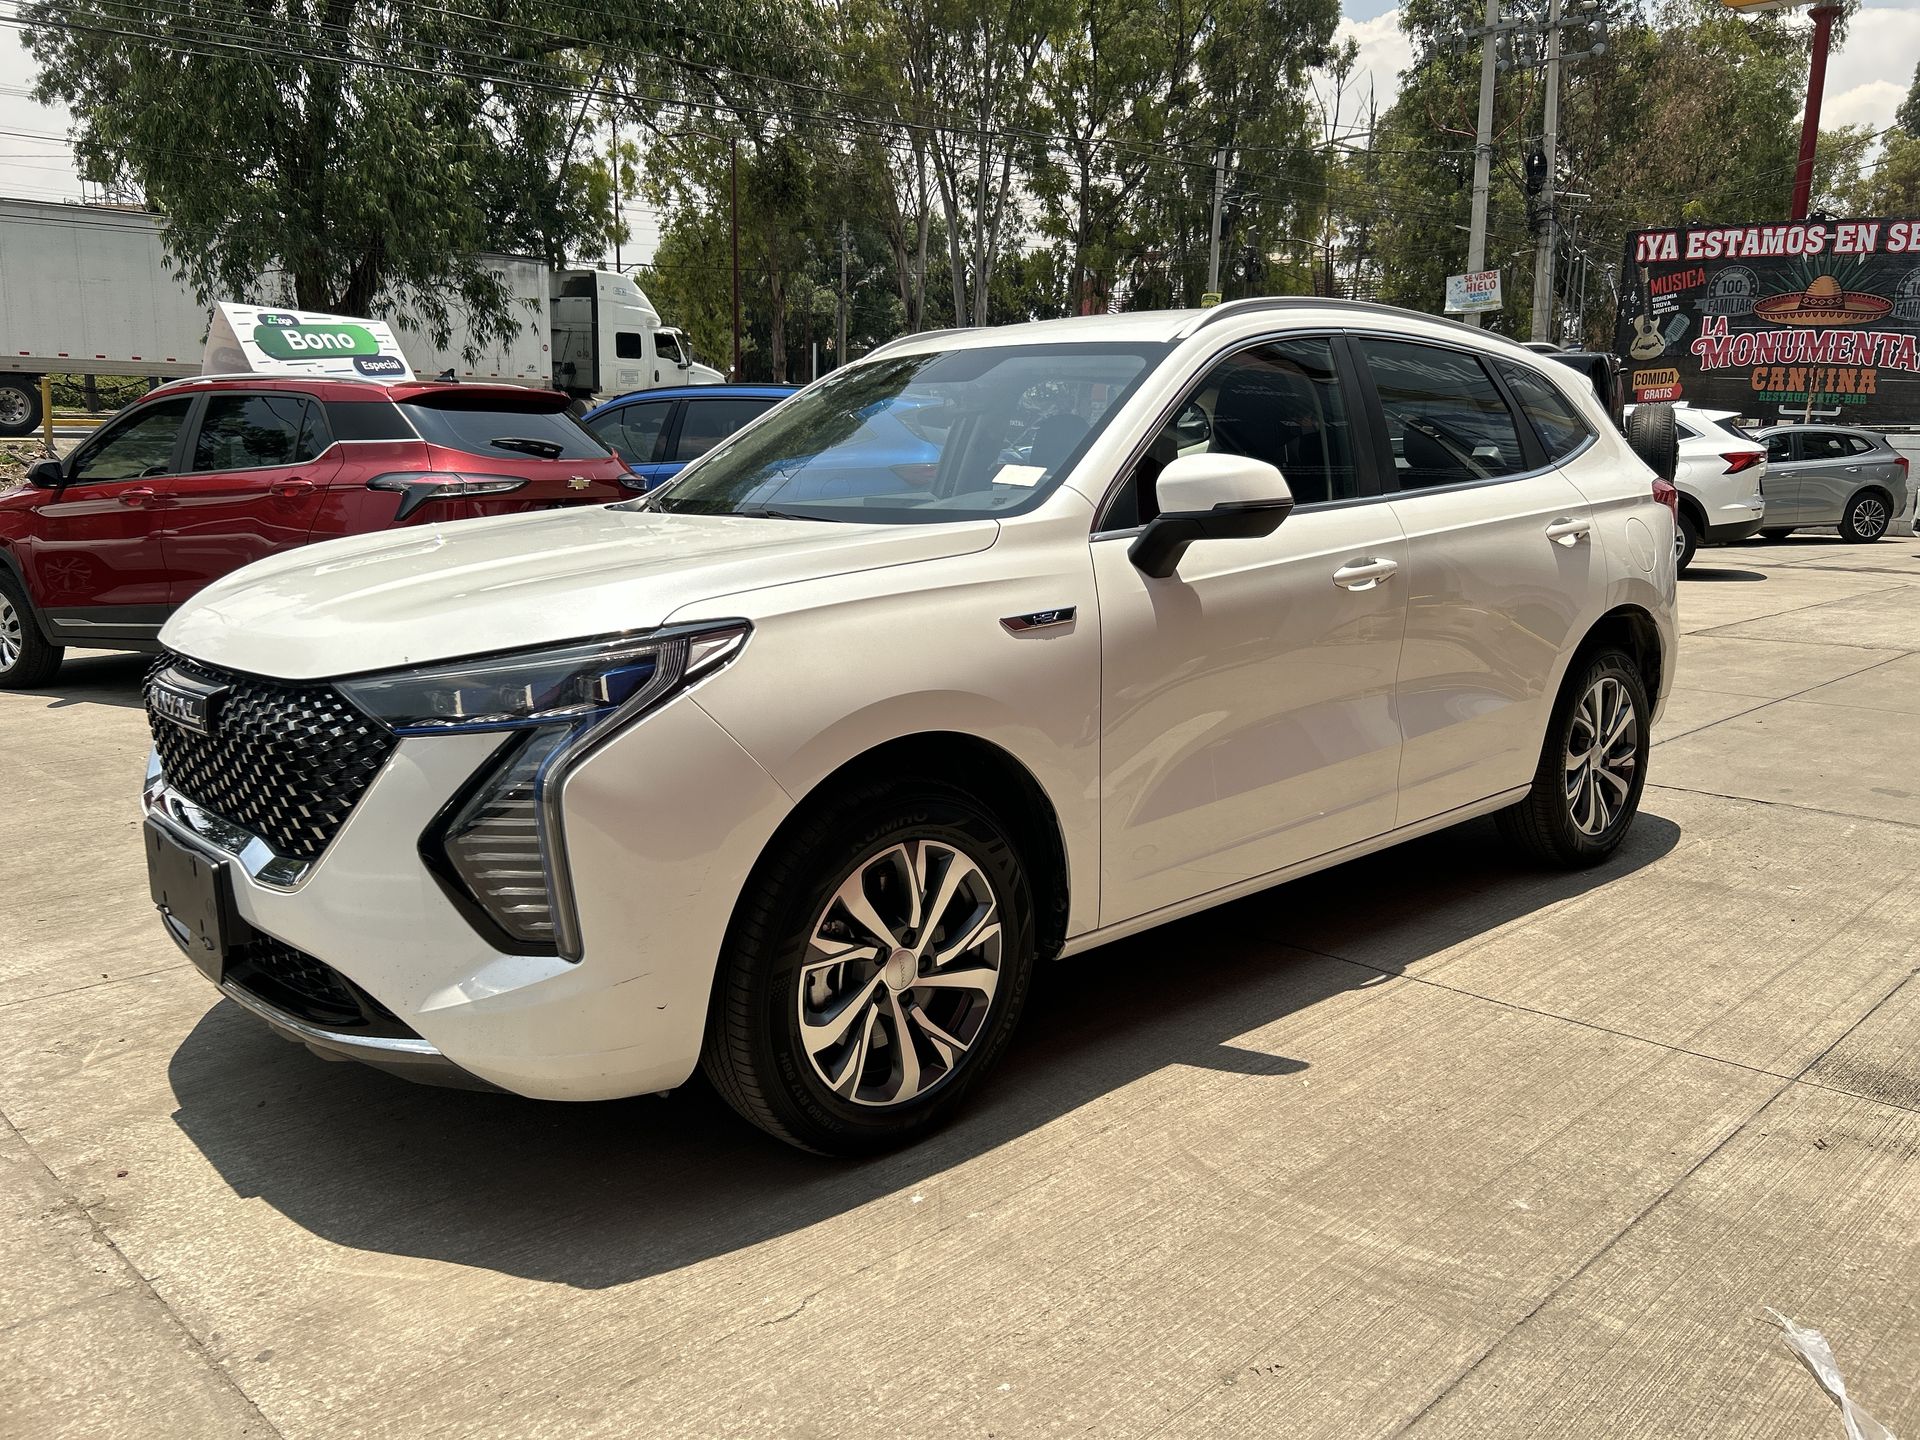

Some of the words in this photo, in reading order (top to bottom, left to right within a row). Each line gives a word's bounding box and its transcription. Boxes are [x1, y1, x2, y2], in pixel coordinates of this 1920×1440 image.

[1636, 233, 1678, 262] ¡YA
[1688, 226, 1825, 258] ESTAMOS
[1835, 224, 1879, 252] EN
[1464, 274, 1473, 282] SE
[1475, 271, 1498, 281] VENDE
[1650, 268, 1706, 296] MUSICA
[1466, 280, 1497, 293] HIELO
[1652, 301, 1672, 309] TROVA
[1708, 299, 1752, 313] FAMILIAR
[1702, 316, 1728, 337] LA
[281, 329, 355, 350] Bono
[1691, 329, 1920, 372] MONUMENTA
[361, 360, 400, 371] Especial
[1635, 371, 1675, 386] COMIDA
[1750, 367, 1877, 393] CANTINA
[1644, 388, 1673, 400] GRATIS
